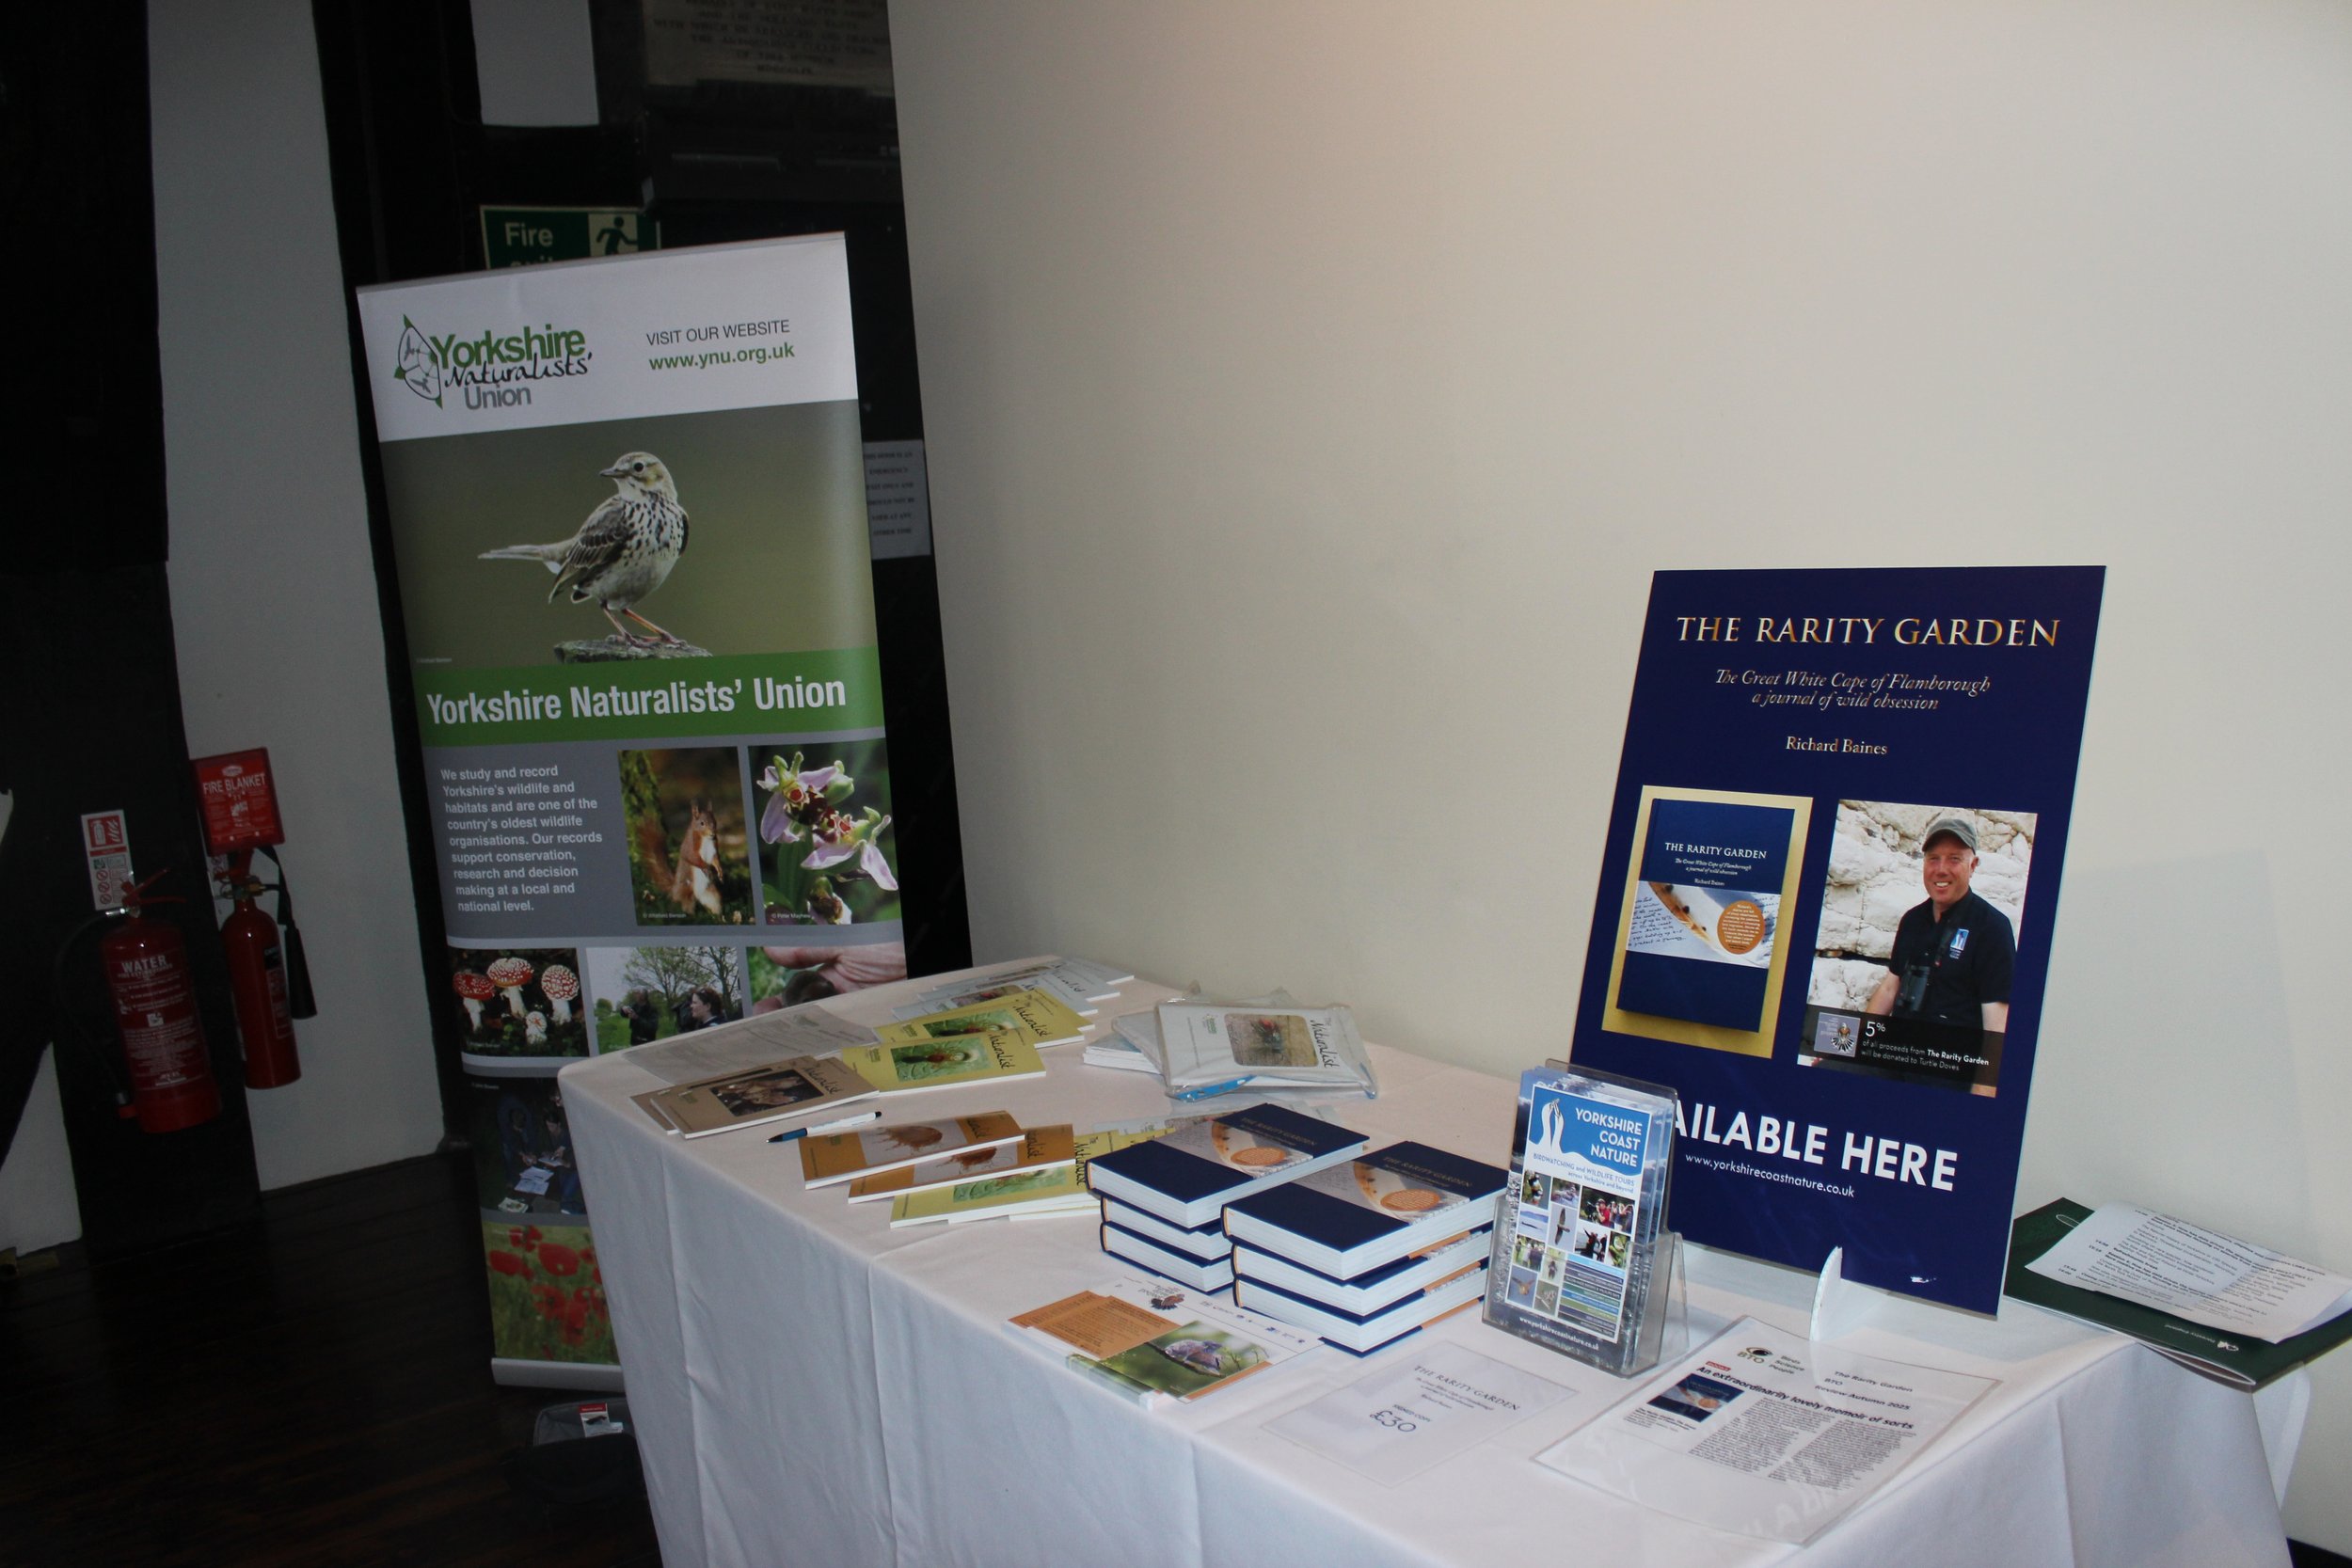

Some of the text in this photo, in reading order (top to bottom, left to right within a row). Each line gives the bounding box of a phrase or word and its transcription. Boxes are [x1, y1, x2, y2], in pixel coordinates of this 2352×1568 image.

[504, 222, 553, 246] Fire
[646, 320, 790, 346] VISIT OUR WEBSITE
[429, 324, 586, 370] Yorkshire
[648, 341, 795, 370] www.ynu.org.uk
[464, 384, 532, 411] Union
[1677, 617, 2060, 647] THE RARITY GARDEN
[1716, 670, 1991, 697] The Great White Cape of Flamborough
[426, 689, 561, 724] Yorkshire
[754, 676, 846, 710] Union
[1752, 689, 1939, 710] a journal of wild obsession
[1786, 736, 1887, 756] Richard Baines
[202, 773, 265, 794] FIRE BLANKET
[440, 766, 558, 782] We study and record
[442, 782, 575, 798] Yorkshire's wildlife and
[445, 799, 597, 814] habitats and are one of the
[447, 816, 582, 832] country's oldest wildlife
[450, 832, 603, 849] organisations. Our records
[1665, 843, 1767, 859] THE RARITY GARDEN
[452, 850, 576, 865] support conservation,
[453, 866, 579, 879] research and decision
[455, 882, 575, 898] making at a local and
[458, 900, 534, 912] national level.
[121, 955, 167, 973] WATER
[1865, 1021, 1886, 1037] 5%
[1310, 1020, 1340, 1068] Naturalist
[1879, 1043, 1909, 1054] proceeds
[1910, 1046, 1926, 1054] from
[1927, 1049, 1940, 1058] The
[1941, 1051, 1963, 1063] Rarity
[1963, 1054, 1989, 1066] Garden
[1883, 1053, 1909, 1064] donated
[1919, 1058, 1937, 1068] Turtle
[1939, 1061, 1960, 1070] Doves
[1575, 1106, 1643, 1136] YORKSHIRE
[1599, 1132, 1642, 1150] COAST
[1675, 1100, 1958, 1192] AILABLE HERE
[1591, 1144, 1638, 1167] NATURE
[1534, 1153, 1575, 1170] BIRDWATCHING
[1586, 1167, 1613, 1181] WILDLIFE
[1613, 1175, 1634, 1186] TOURS
[1685, 1154, 1854, 1197] www.yorkshirecoastnature.co.uk
[1583, 1174, 1605, 1186] Yorkshire
[1615, 1182, 1634, 1194] beyond
[1737, 1351, 1765, 1364] BTO
[1414, 1366, 1435, 1376] THE
[1436, 1374, 1472, 1392] RARITY
[1473, 1390, 1520, 1411] GARDEN
[1851, 1376, 1878, 1385] Rarity
[1880, 1382, 1913, 1392] Garden
[1712, 1371, 1789, 1400] extraordinarily
[1790, 1396, 1823, 1409] lovely
[1824, 1405, 1867, 1419] memoir
[1883, 1419, 1915, 1429] sorts
[1849, 1393, 1885, 1405] Autumn
[1370, 1410, 1417, 1432] £30
